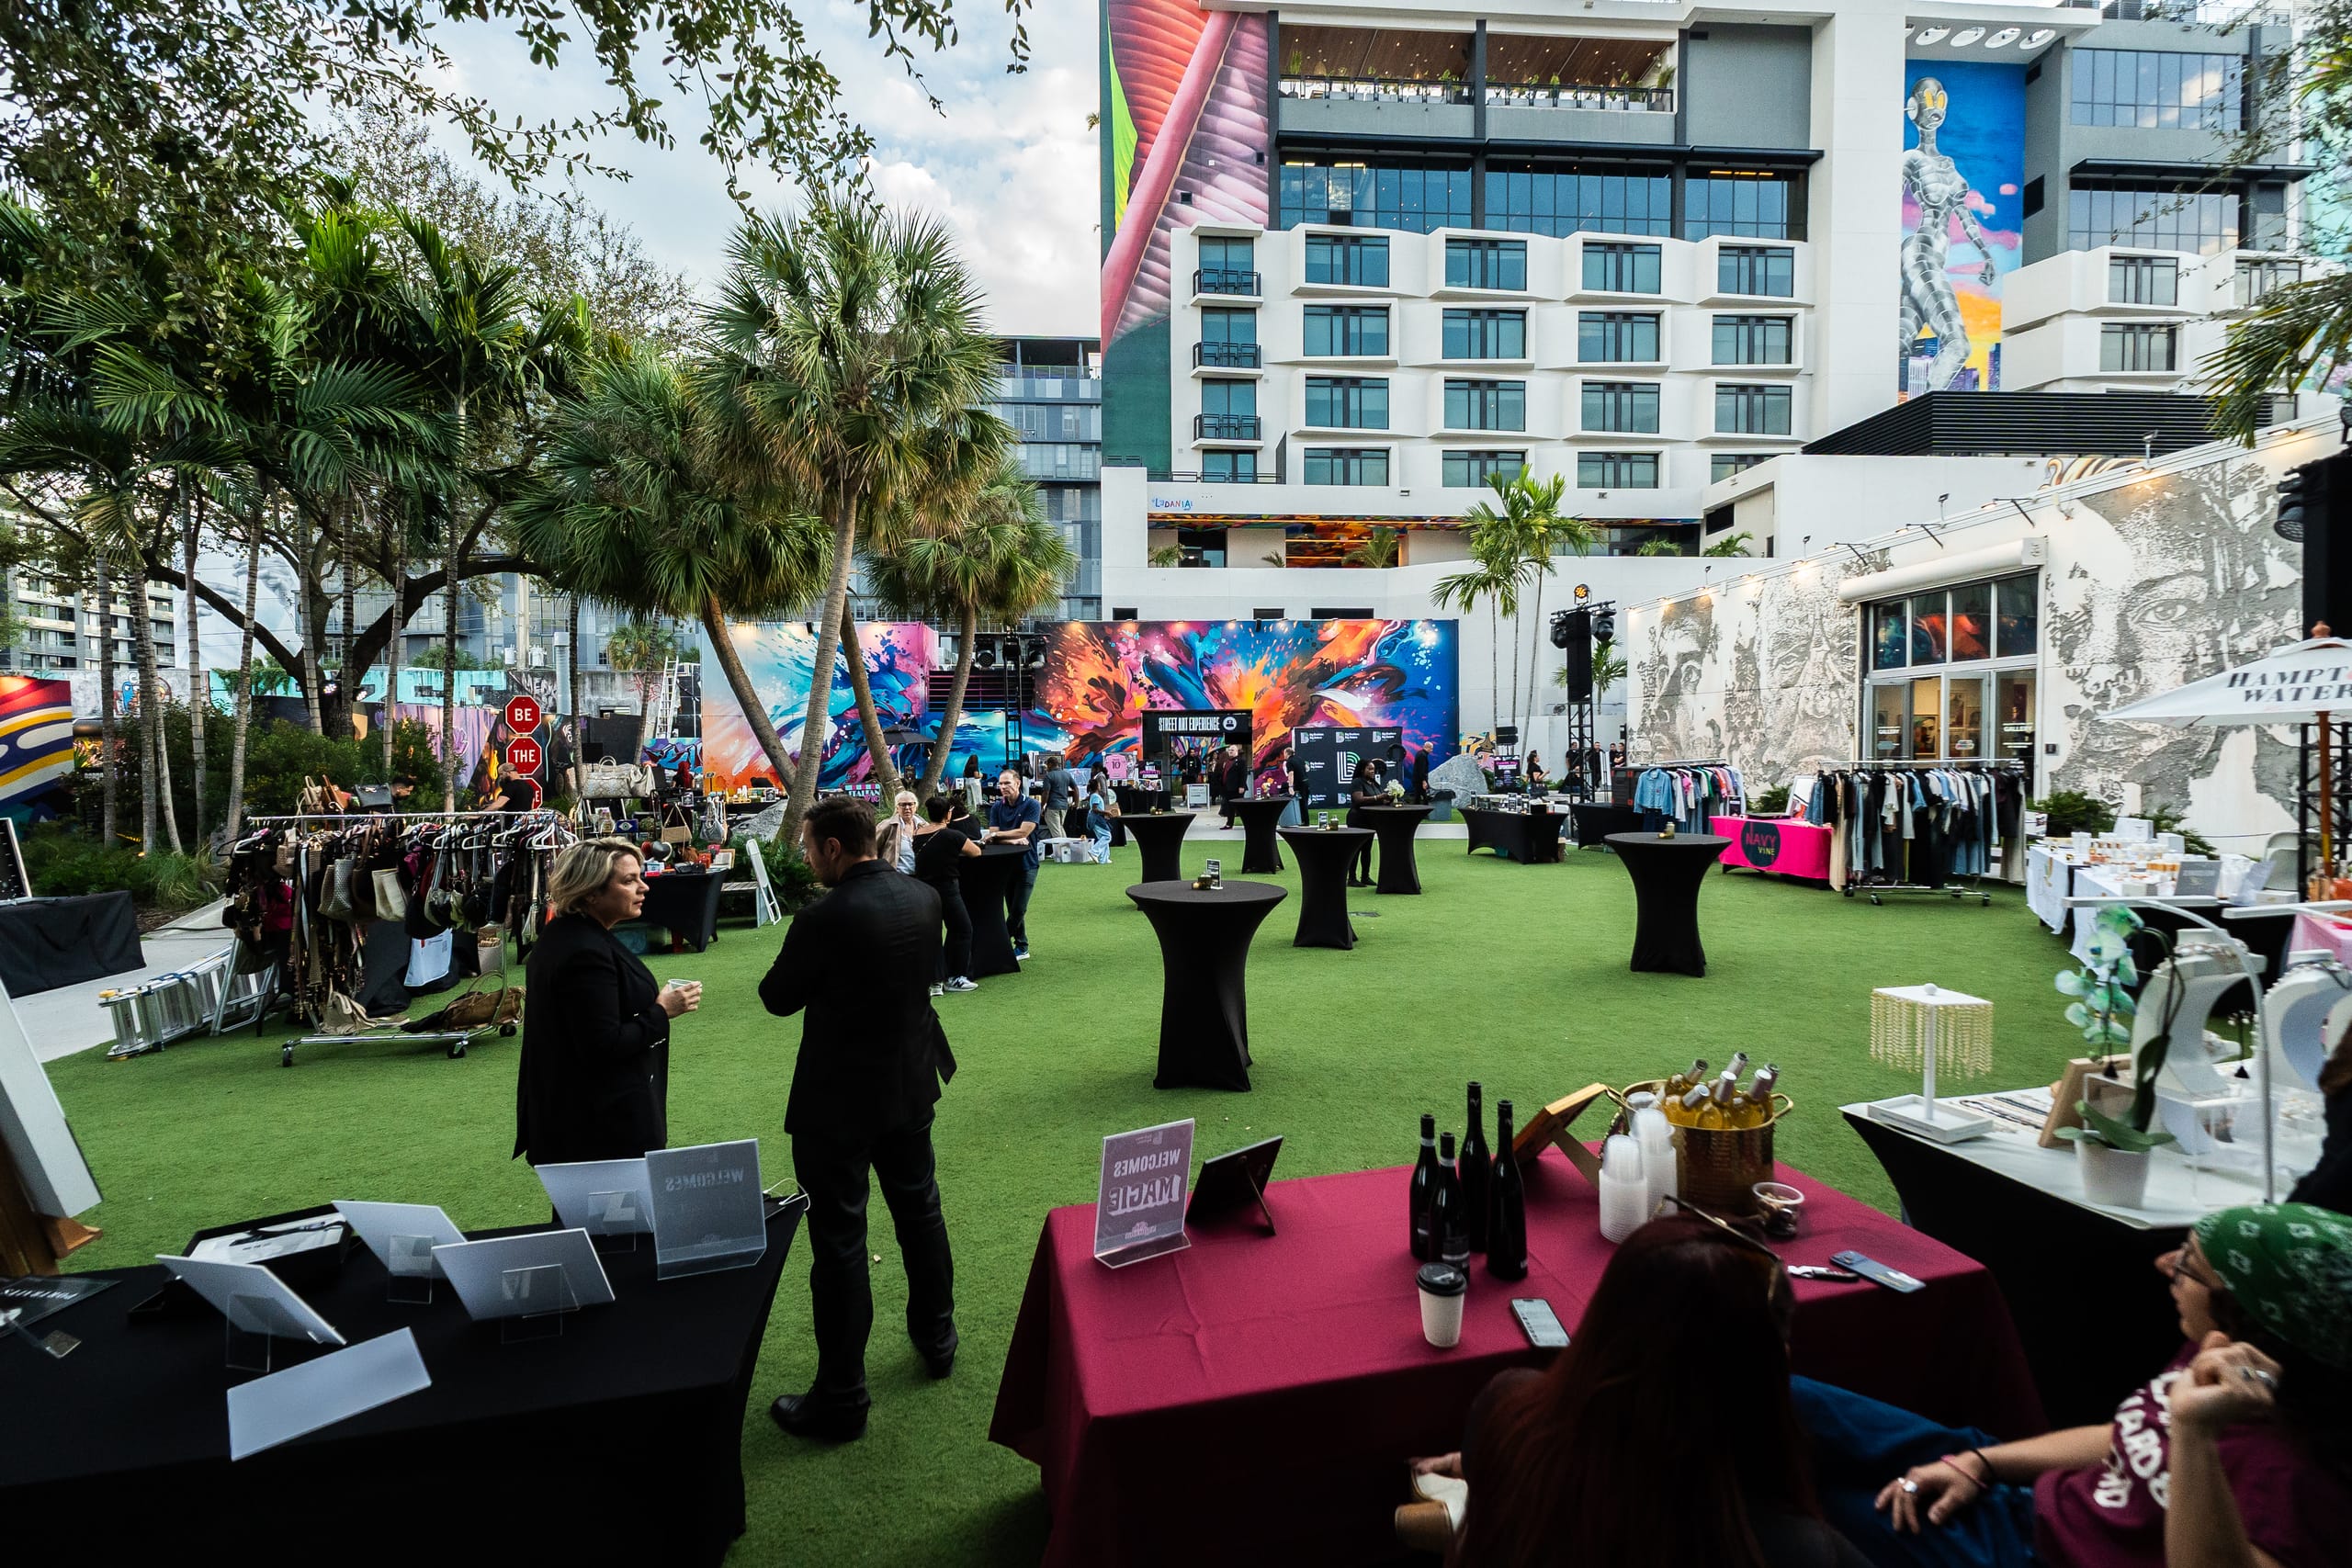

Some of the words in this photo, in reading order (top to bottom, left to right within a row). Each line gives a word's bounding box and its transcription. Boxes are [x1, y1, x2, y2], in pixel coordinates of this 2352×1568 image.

[2227, 666, 2352, 688] HAMPT
[2245, 683, 2352, 702] WATER
[514, 708, 533, 722] BE
[1159, 716, 1177, 731] STREET
[1189, 716, 1220, 731] EXPERIENCE
[514, 750, 536, 762] THE
[1746, 832, 1777, 847] NAVY
[1758, 846, 1775, 856] VINE
